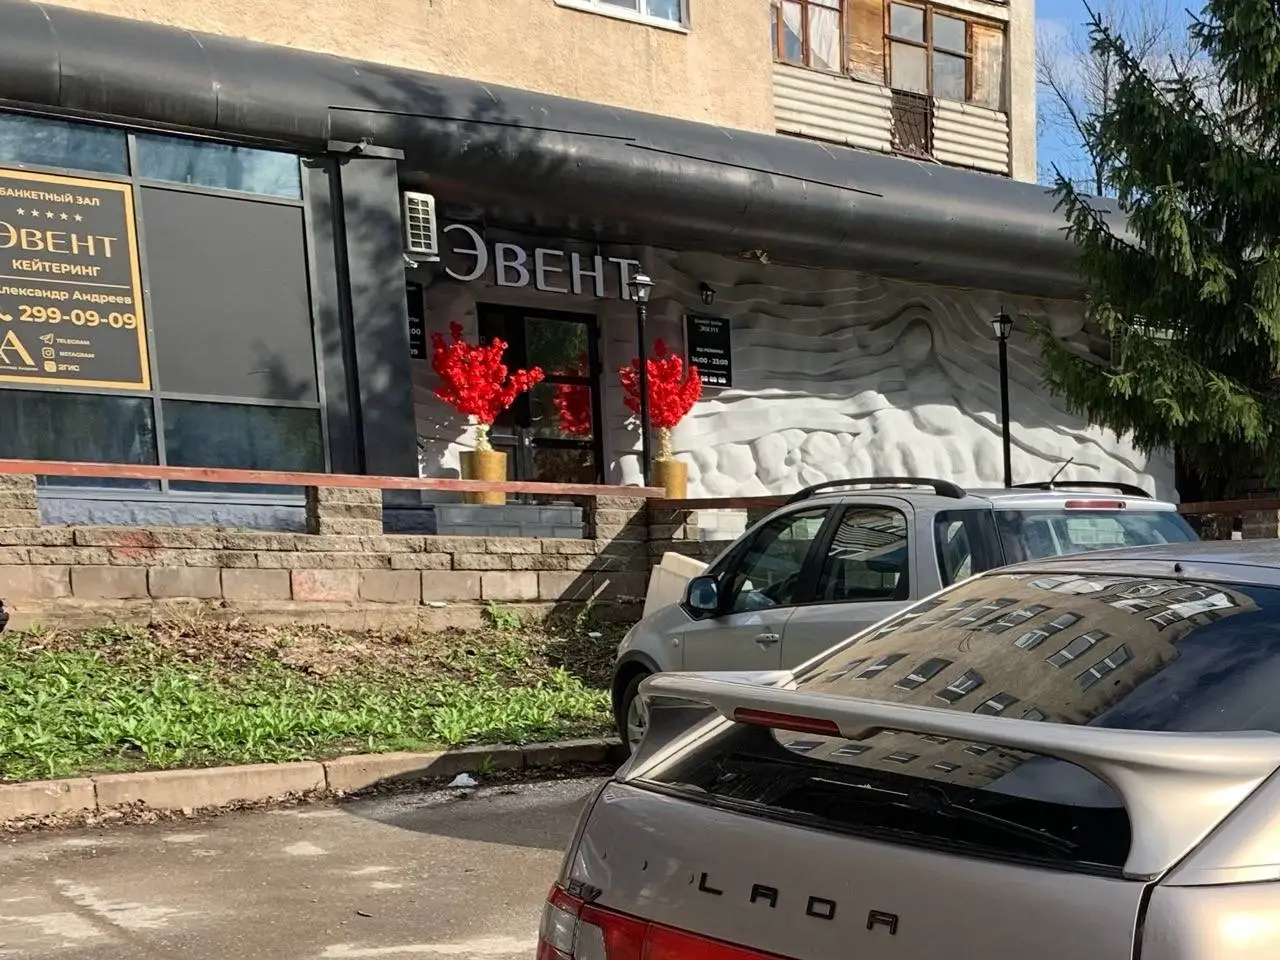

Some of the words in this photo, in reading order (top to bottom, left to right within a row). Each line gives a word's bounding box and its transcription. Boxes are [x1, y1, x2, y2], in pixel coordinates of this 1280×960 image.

[0, 187, 73, 203] БАНКЕТНЫЙ
[75, 195, 101, 206] ЗАЛ
[0, 220, 118, 258] ЭВЕНТ
[12, 258, 102, 277] КЕЙТЕРИНГ
[443, 223, 640, 300] ЭВЕНТ
[0, 285, 69, 301] лександр
[72, 290, 133, 304] Андреев
[18, 304, 137, 329] 299-09-09
[58, 364, 80, 372] 2ГИС
[698, 872, 899, 936] LADA
